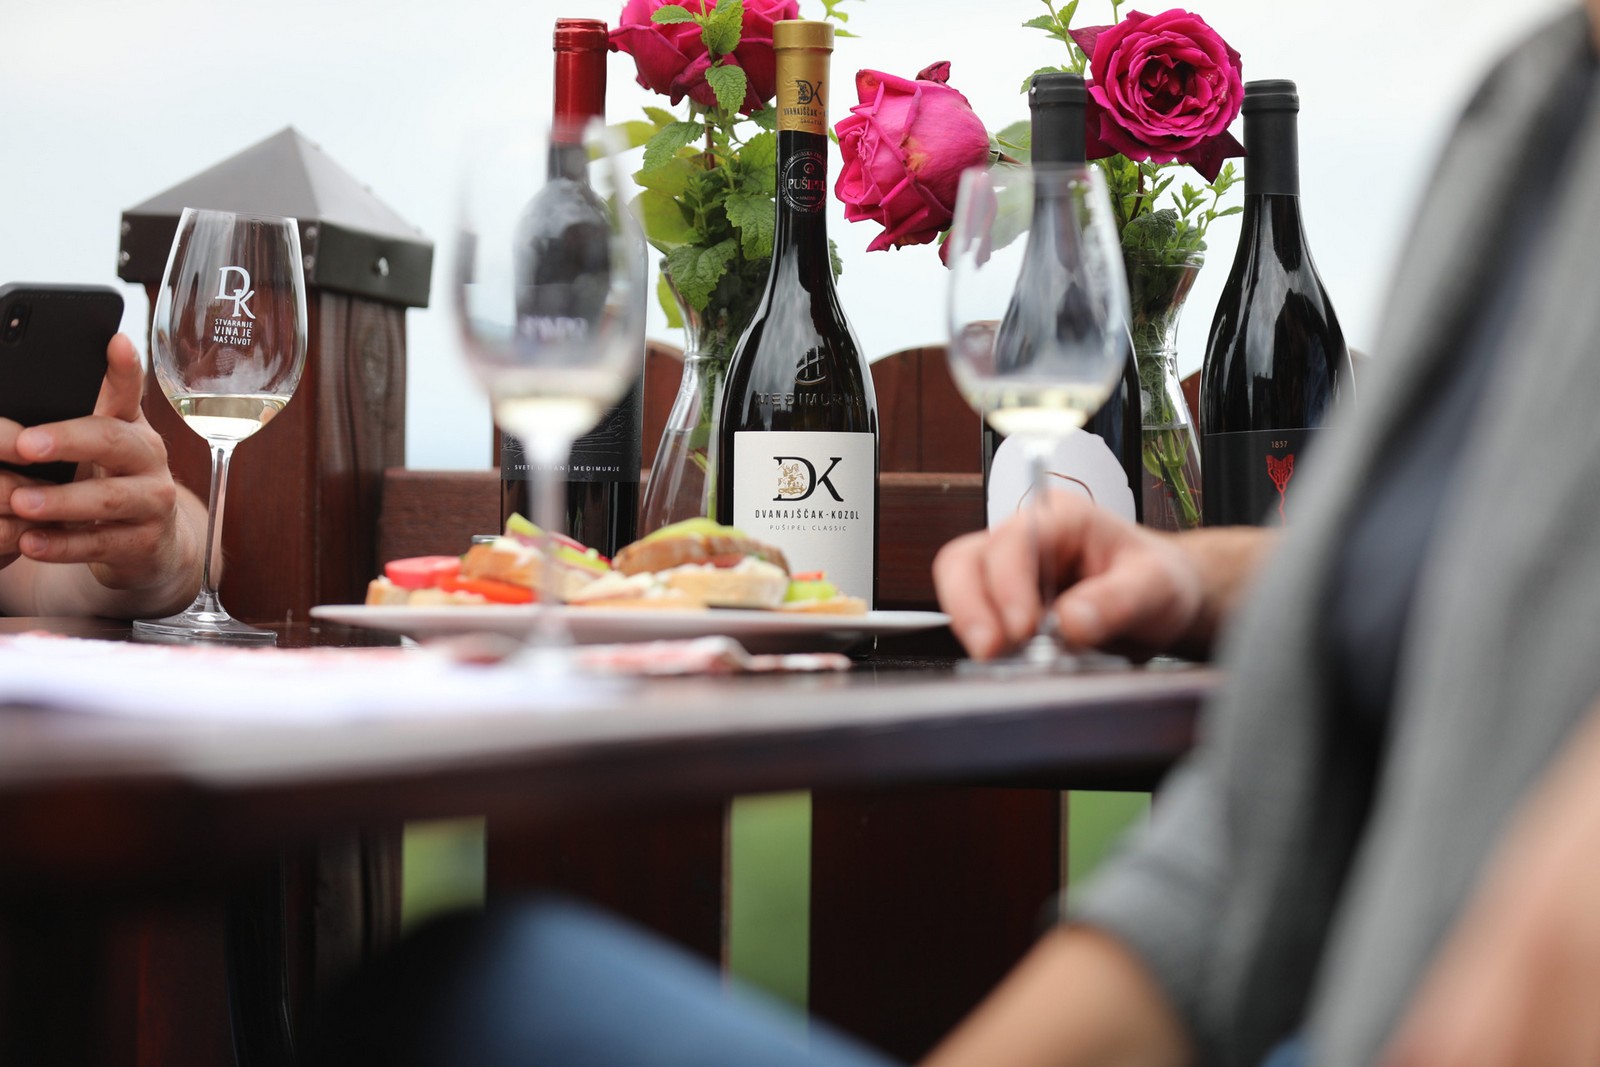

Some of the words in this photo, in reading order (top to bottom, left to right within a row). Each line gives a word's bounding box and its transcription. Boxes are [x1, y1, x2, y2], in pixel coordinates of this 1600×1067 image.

[215, 266, 256, 319] DK
[215, 319, 253, 328] STVARANJE
[214, 326, 239, 336] VINA
[242, 328, 252, 338] JE
[213, 336, 228, 344] NAŠ
[230, 336, 252, 346] ŽIVOT
[772, 456, 845, 502] DK
[755, 508, 860, 520] DVANAJŠČAK-KOZOL
[769, 523, 806, 532] PUŠIPEL
[811, 524, 847, 532] CLASSIC
